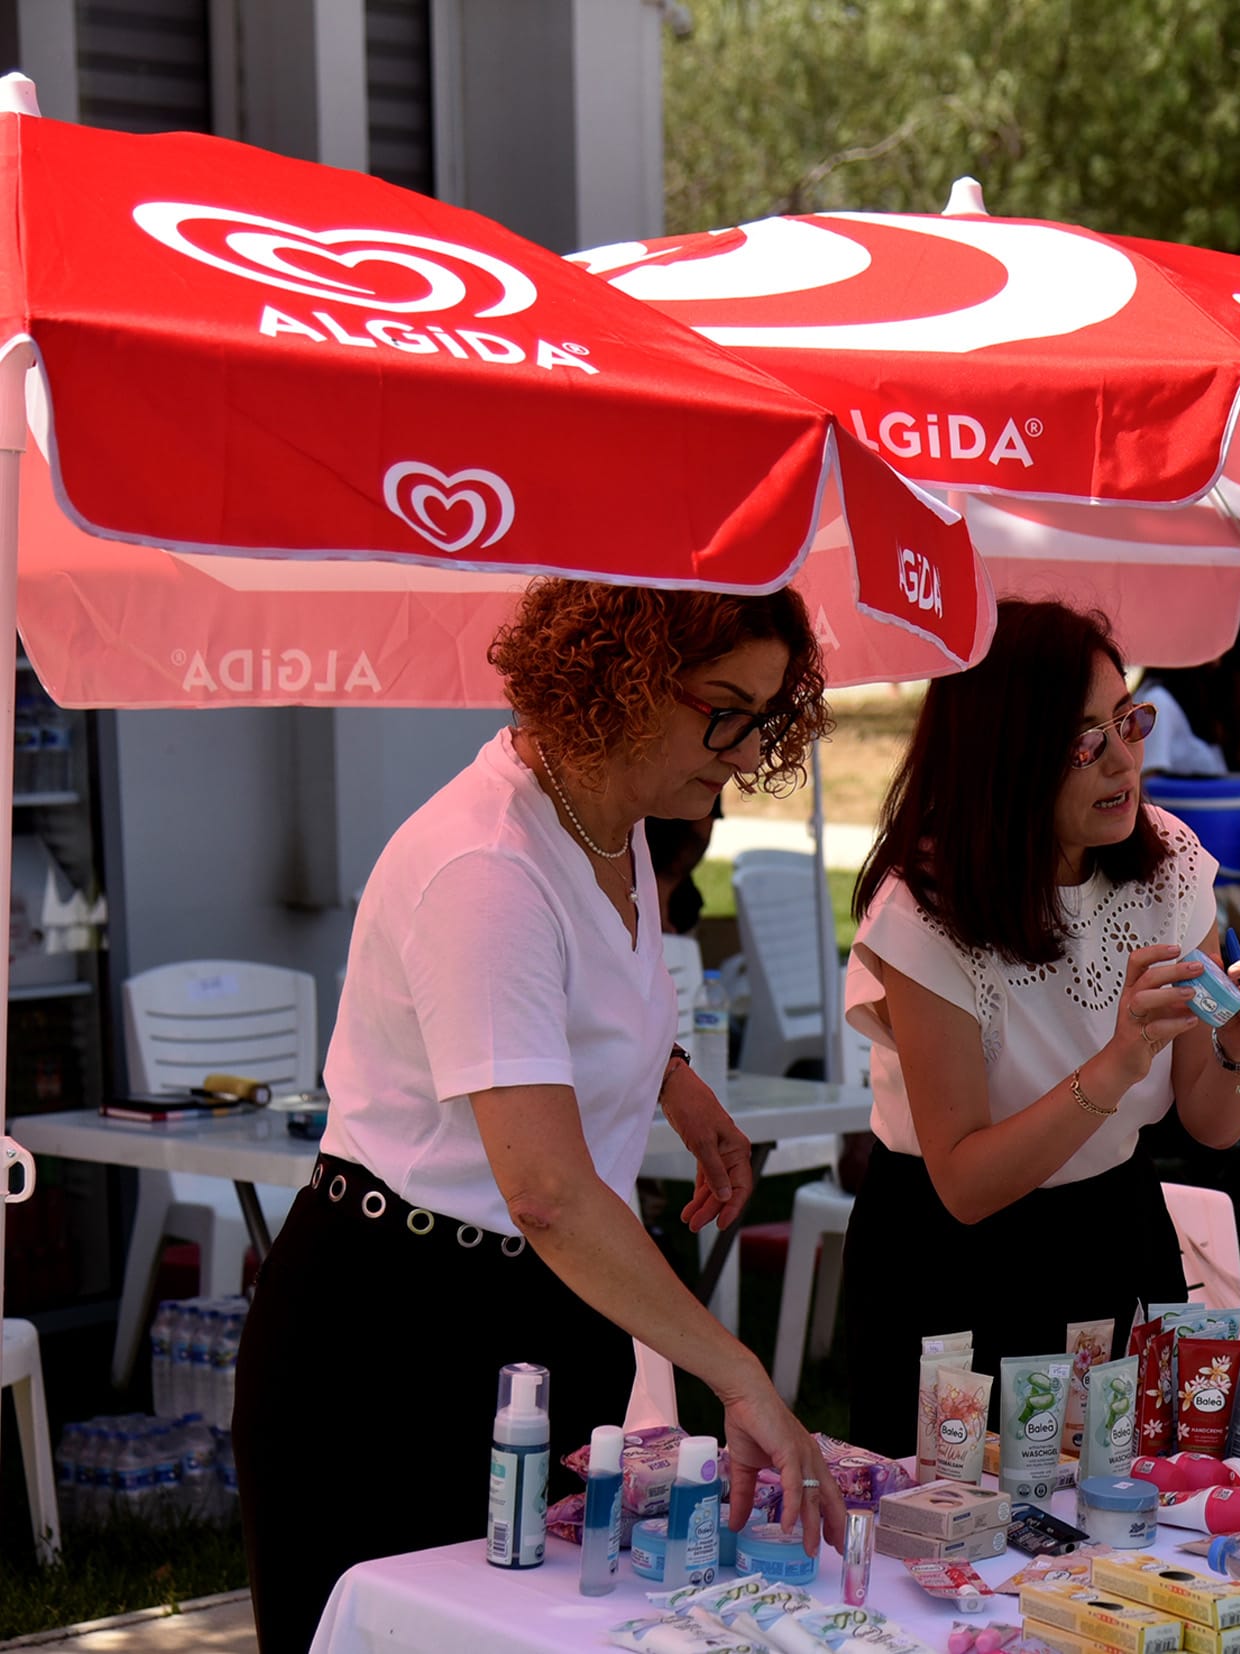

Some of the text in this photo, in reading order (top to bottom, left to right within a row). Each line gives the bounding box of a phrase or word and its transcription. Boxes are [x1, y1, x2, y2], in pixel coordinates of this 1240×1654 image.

[850, 409, 1034, 468] LGiDA
[1196, 1395, 1222, 1406] Balea
[942, 1425, 964, 1439] Balea
[1028, 1420, 1054, 1434] Balea
[1112, 1423, 1131, 1439] Balea
